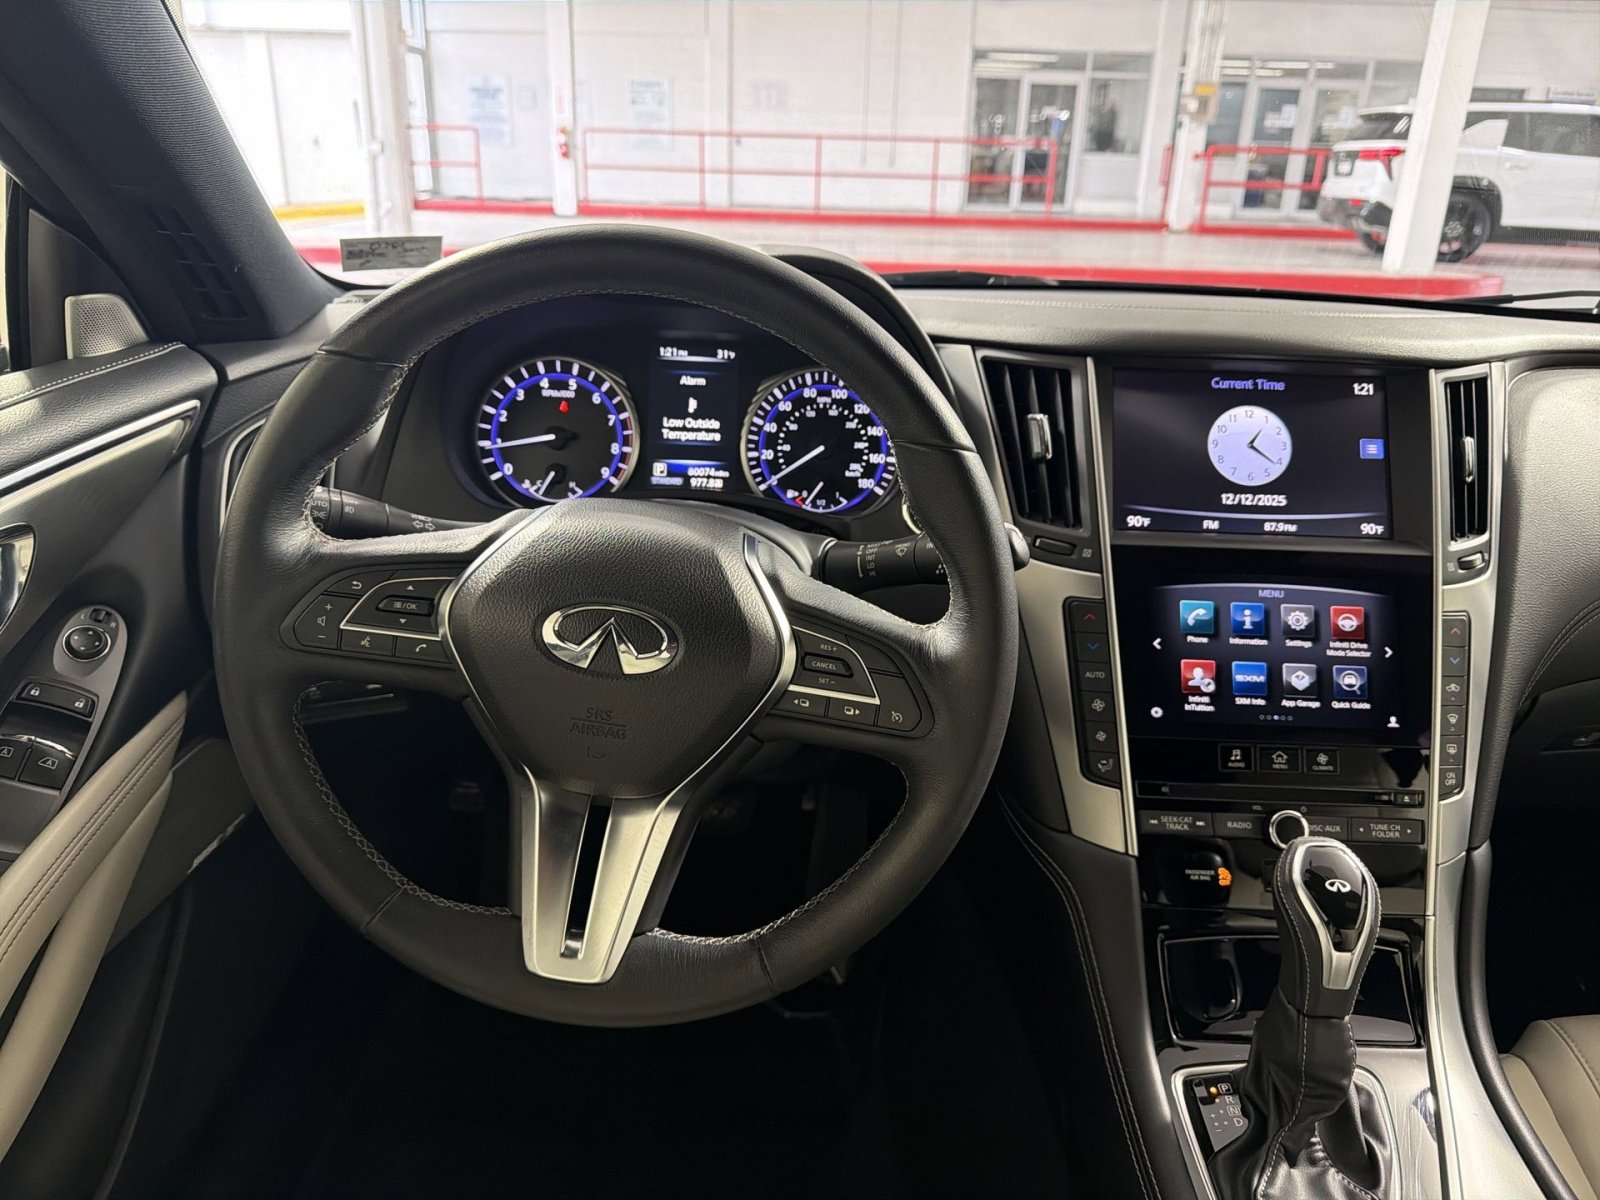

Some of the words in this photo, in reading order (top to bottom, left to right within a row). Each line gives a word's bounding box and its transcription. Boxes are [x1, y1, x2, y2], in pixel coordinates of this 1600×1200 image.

[540, 377, 549, 389] 4
[569, 379, 578, 390] 5
[680, 375, 706, 386] Alarm
[1211, 377, 1254, 390] Current
[1256, 378, 1286, 391] Time
[803, 388, 817, 398] 80
[831, 389, 848, 399] 100
[1353, 382, 1374, 396] 1:21
[516, 389, 524, 401] 3
[592, 393, 601, 404] 6
[778, 401, 792, 411] 60
[854, 404, 870, 414] 120
[499, 410, 507, 422] 2
[1229, 414, 1237, 423] 11
[1244, 410, 1254, 419] 12
[1264, 415, 1268, 424] 1
[608, 415, 616, 426] 7
[663, 417, 684, 428] Low
[685, 417, 720, 429] Outside
[764, 422, 777, 433] 40
[867, 426, 883, 436] 140
[1217, 425, 1226, 434] 10
[1276, 427, 1282, 436] 2
[662, 428, 721, 441] Temperature
[611, 443, 620, 454] 8
[1212, 440, 1218, 449] 9
[1281, 442, 1287, 451] 3
[761, 450, 774, 459] 20
[869, 453, 885, 463] 160
[1217, 455, 1224, 464] 8
[1276, 457, 1282, 466] 4
[504, 463, 513, 475] 0
[601, 466, 609, 479] 9
[1231, 467, 1236, 476] 7
[1265, 468, 1270, 477] 5
[1248, 472, 1254, 481] 6
[858, 479, 874, 488] 180
[1221, 493, 1287, 507] 12/12/2025
[1203, 520, 1220, 530] FM
[1258, 589, 1284, 598] MENU
[1187, 635, 1209, 645] Phone
[1229, 637, 1268, 646] Information
[1285, 639, 1313, 649] Settings
[1329, 640, 1349, 650] Infiniti
[1350, 641, 1368, 650] Drive
[1326, 649, 1345, 657] Mode
[1345, 649, 1372, 658] Selector
[812, 660, 836, 670] CANCEL
[1085, 671, 1105, 679] AUTO
[1235, 674, 1265, 683] SXM
[1188, 694, 1210, 704] Infiniti
[1235, 697, 1251, 706] SXM
[1252, 697, 1266, 706] Info
[1281, 699, 1296, 709] App
[1297, 700, 1320, 709] Garage
[1331, 701, 1350, 710] Quick
[1351, 701, 1371, 710] Guide
[586, 706, 613, 721] SRS
[569, 721, 627, 740] AIRBAG
[1445, 778, 1456, 786] OFF
[1165, 823, 1190, 831] TRACK
[1227, 821, 1252, 829] RADIO
[1372, 830, 1400, 838] FOLDER
[1225, 1096, 1235, 1104] R
[1233, 1118, 1243, 1126] D
